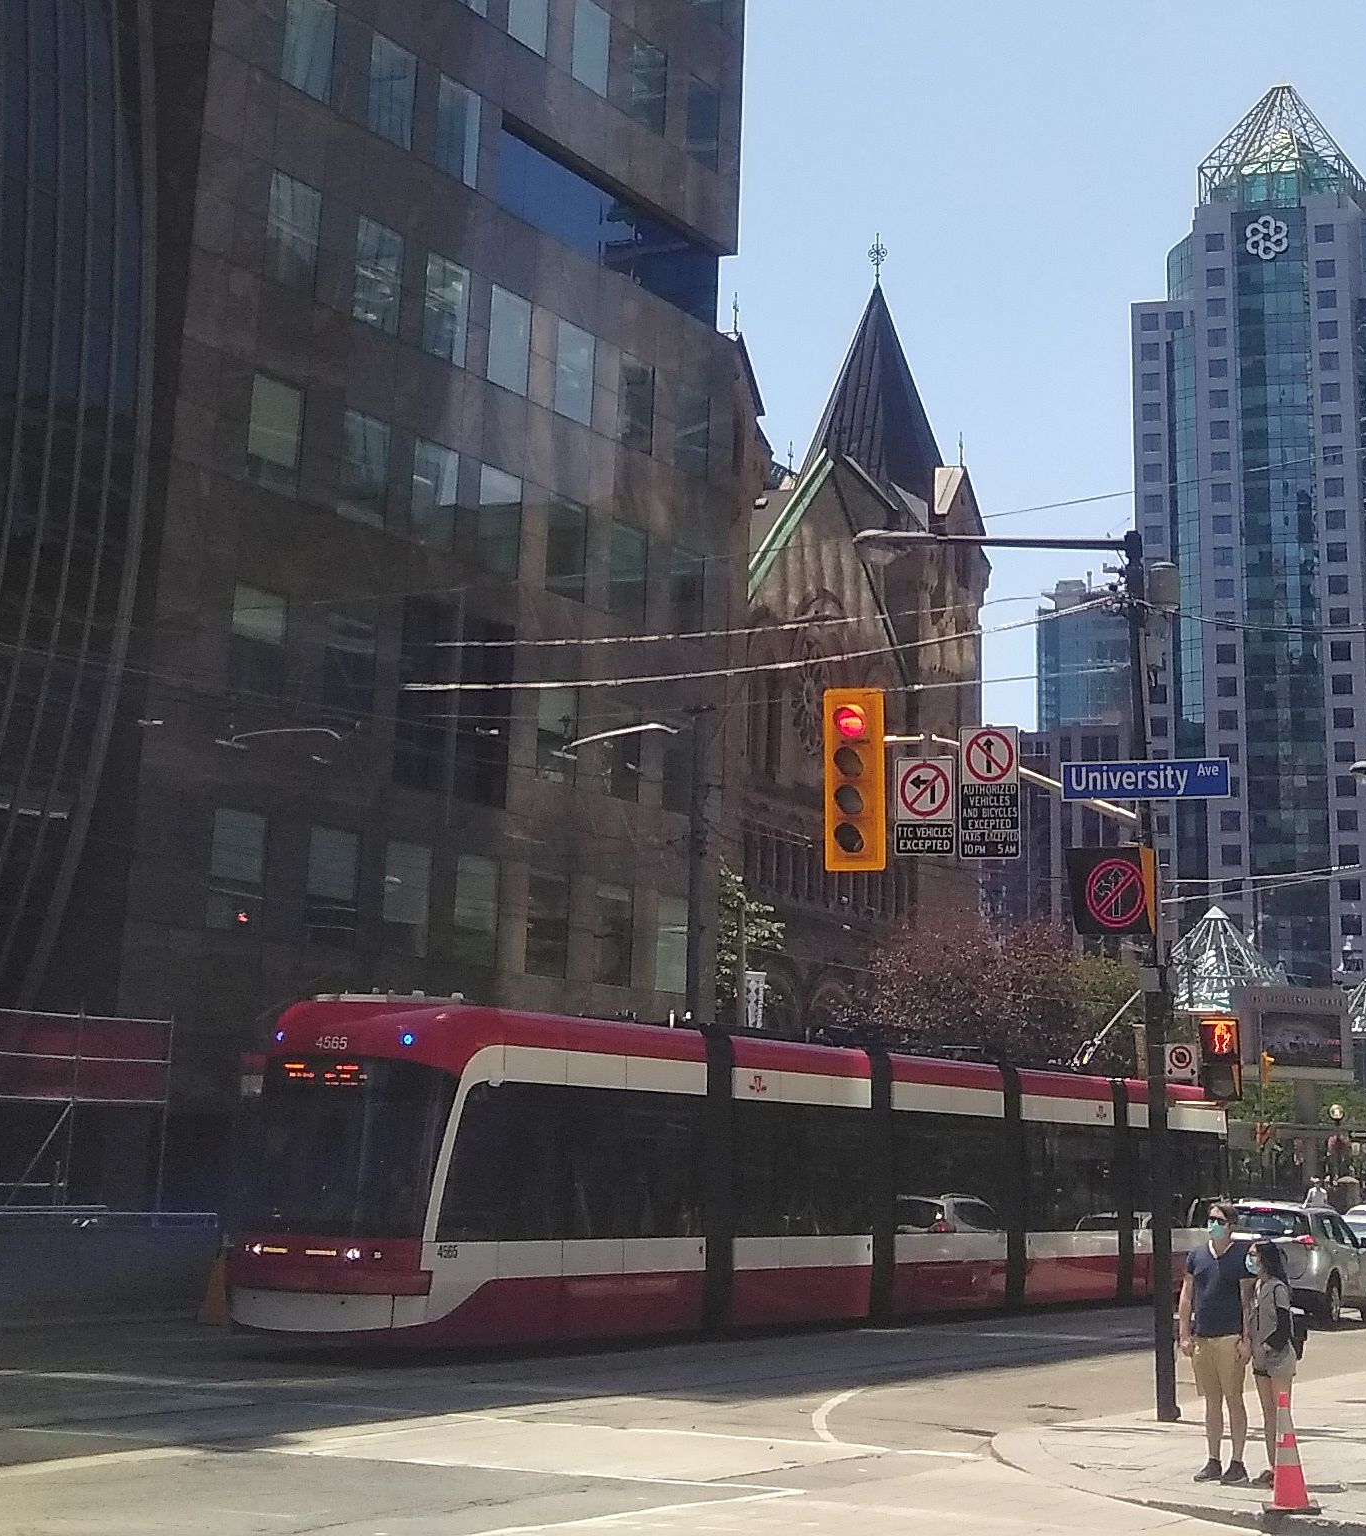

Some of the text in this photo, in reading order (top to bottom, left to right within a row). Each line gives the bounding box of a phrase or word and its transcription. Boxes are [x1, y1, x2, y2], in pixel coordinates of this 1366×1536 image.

[1071, 763, 1219, 795] University Ave
[963, 784, 1016, 795] AUTHORIZED
[969, 795, 1011, 806] VEHICLES
[962, 806, 1018, 818] AND BICYCLES
[968, 818, 1012, 829] EXCEPTED
[898, 826, 953, 838] TTC VEHICLES
[962, 830, 1019, 842] TAXIS EXCEPTED
[899, 839, 951, 851] EXCEPTED
[315, 1035, 348, 1050] 4565
[437, 1244, 458, 1259] 4565
